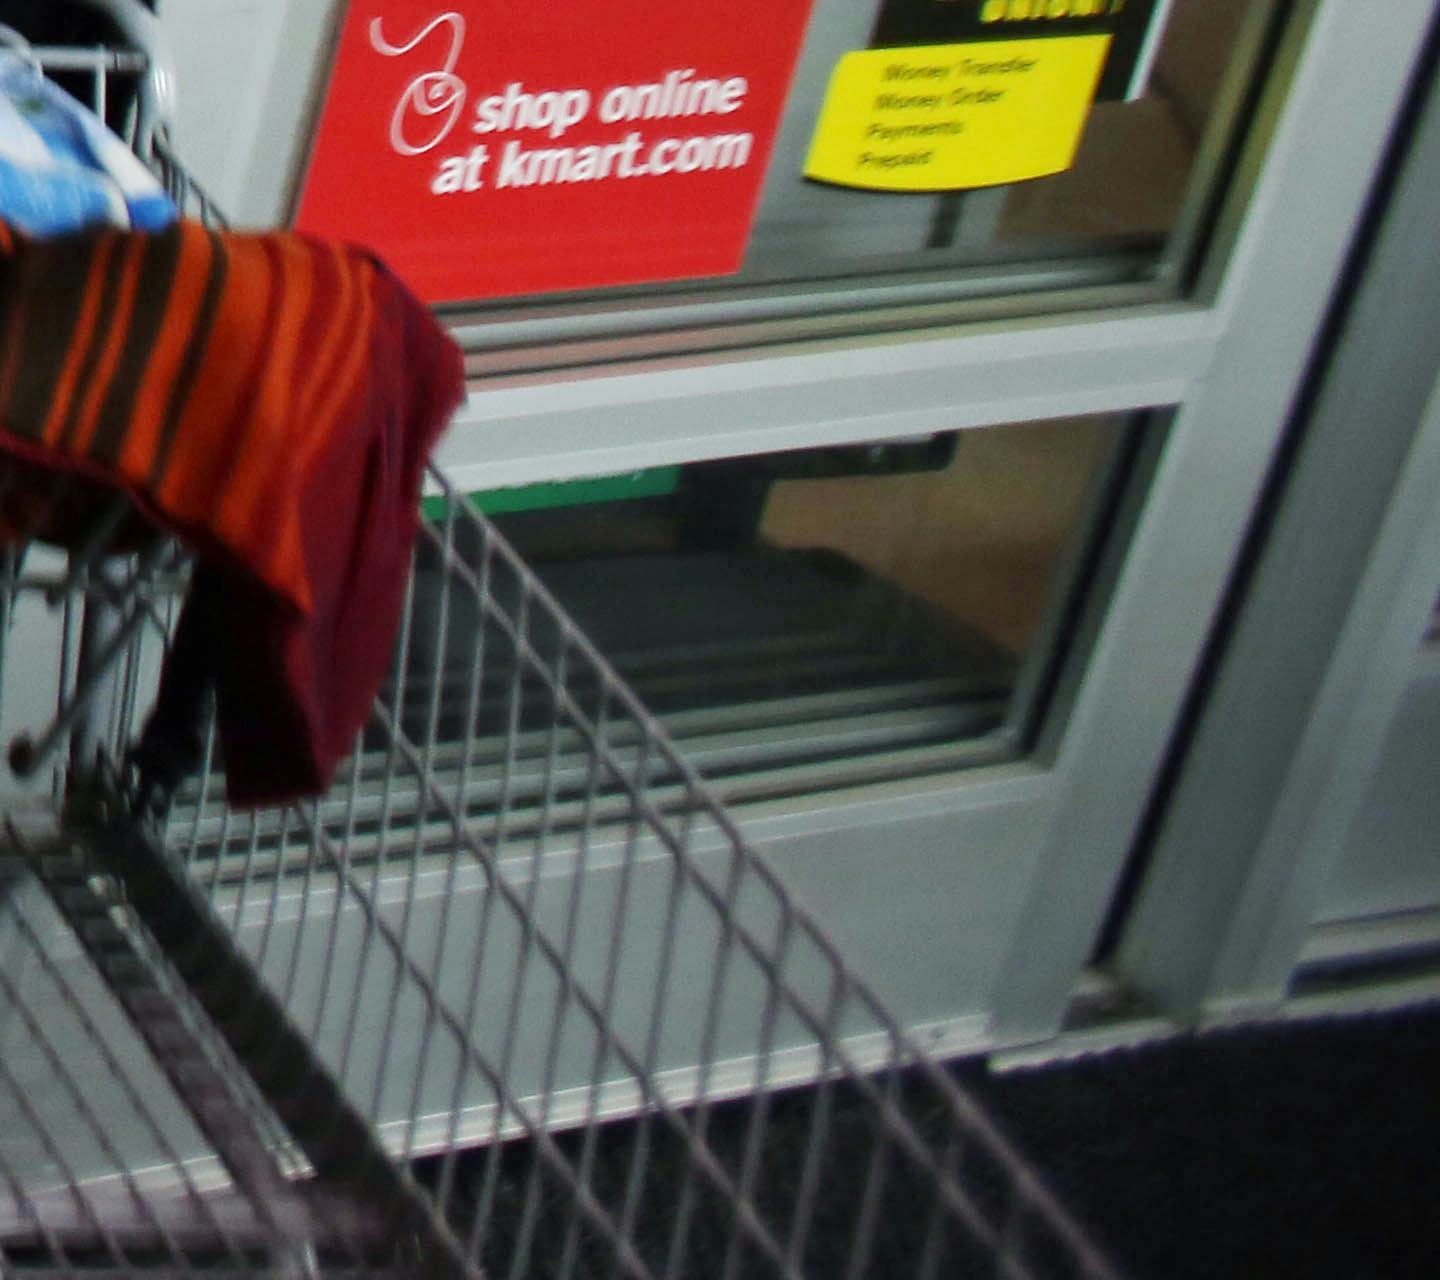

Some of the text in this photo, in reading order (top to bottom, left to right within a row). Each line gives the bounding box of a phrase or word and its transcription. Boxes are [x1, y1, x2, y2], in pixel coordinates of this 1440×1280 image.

[472, 68, 748, 140] shop online
[432, 132, 754, 195] at kmart.com
